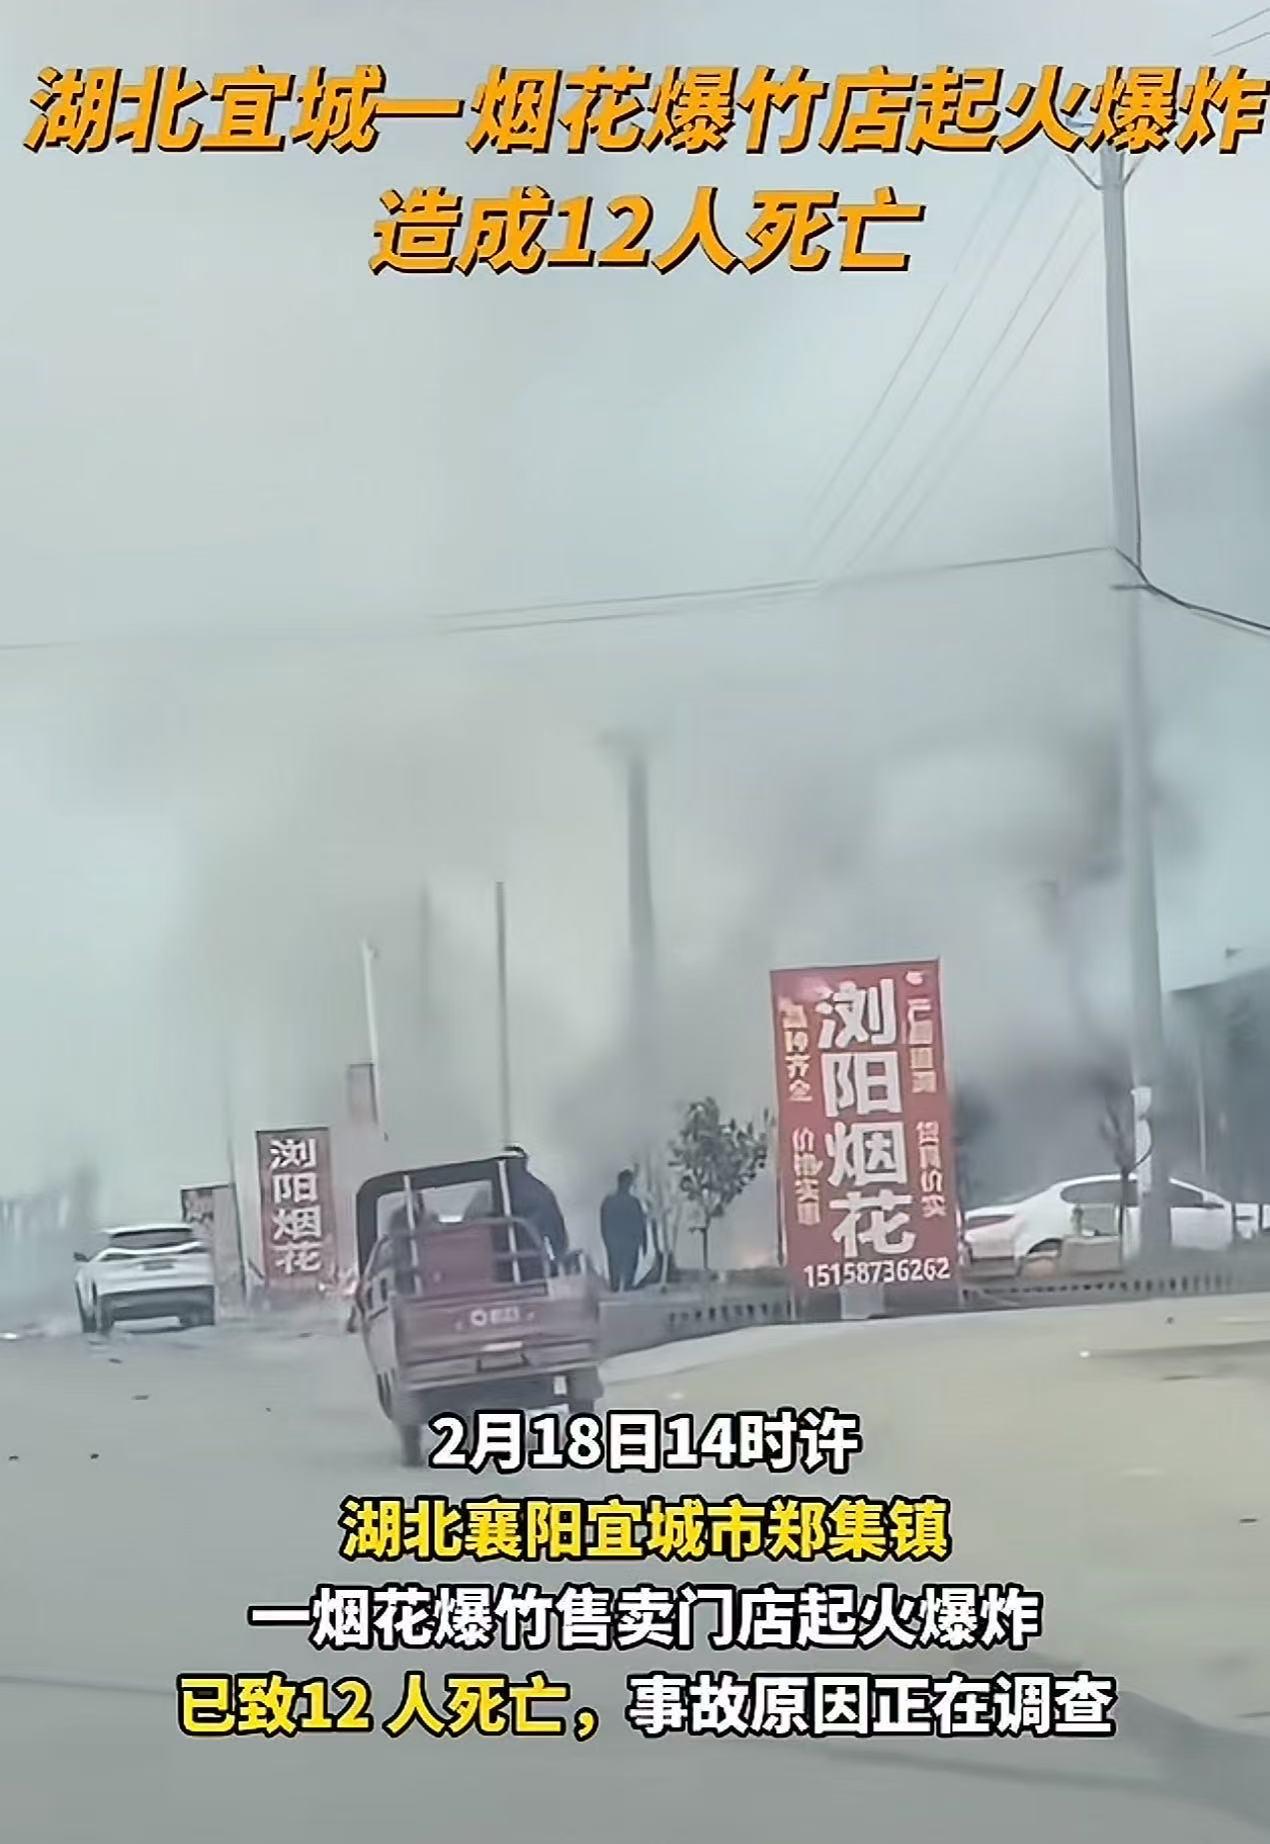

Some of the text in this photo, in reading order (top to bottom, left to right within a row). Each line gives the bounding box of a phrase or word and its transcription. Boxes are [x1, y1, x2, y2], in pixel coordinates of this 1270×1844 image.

[269, 1138, 322, 1275] 浏阳烟花
[816, 978, 916, 1257] 浏阳烟花
